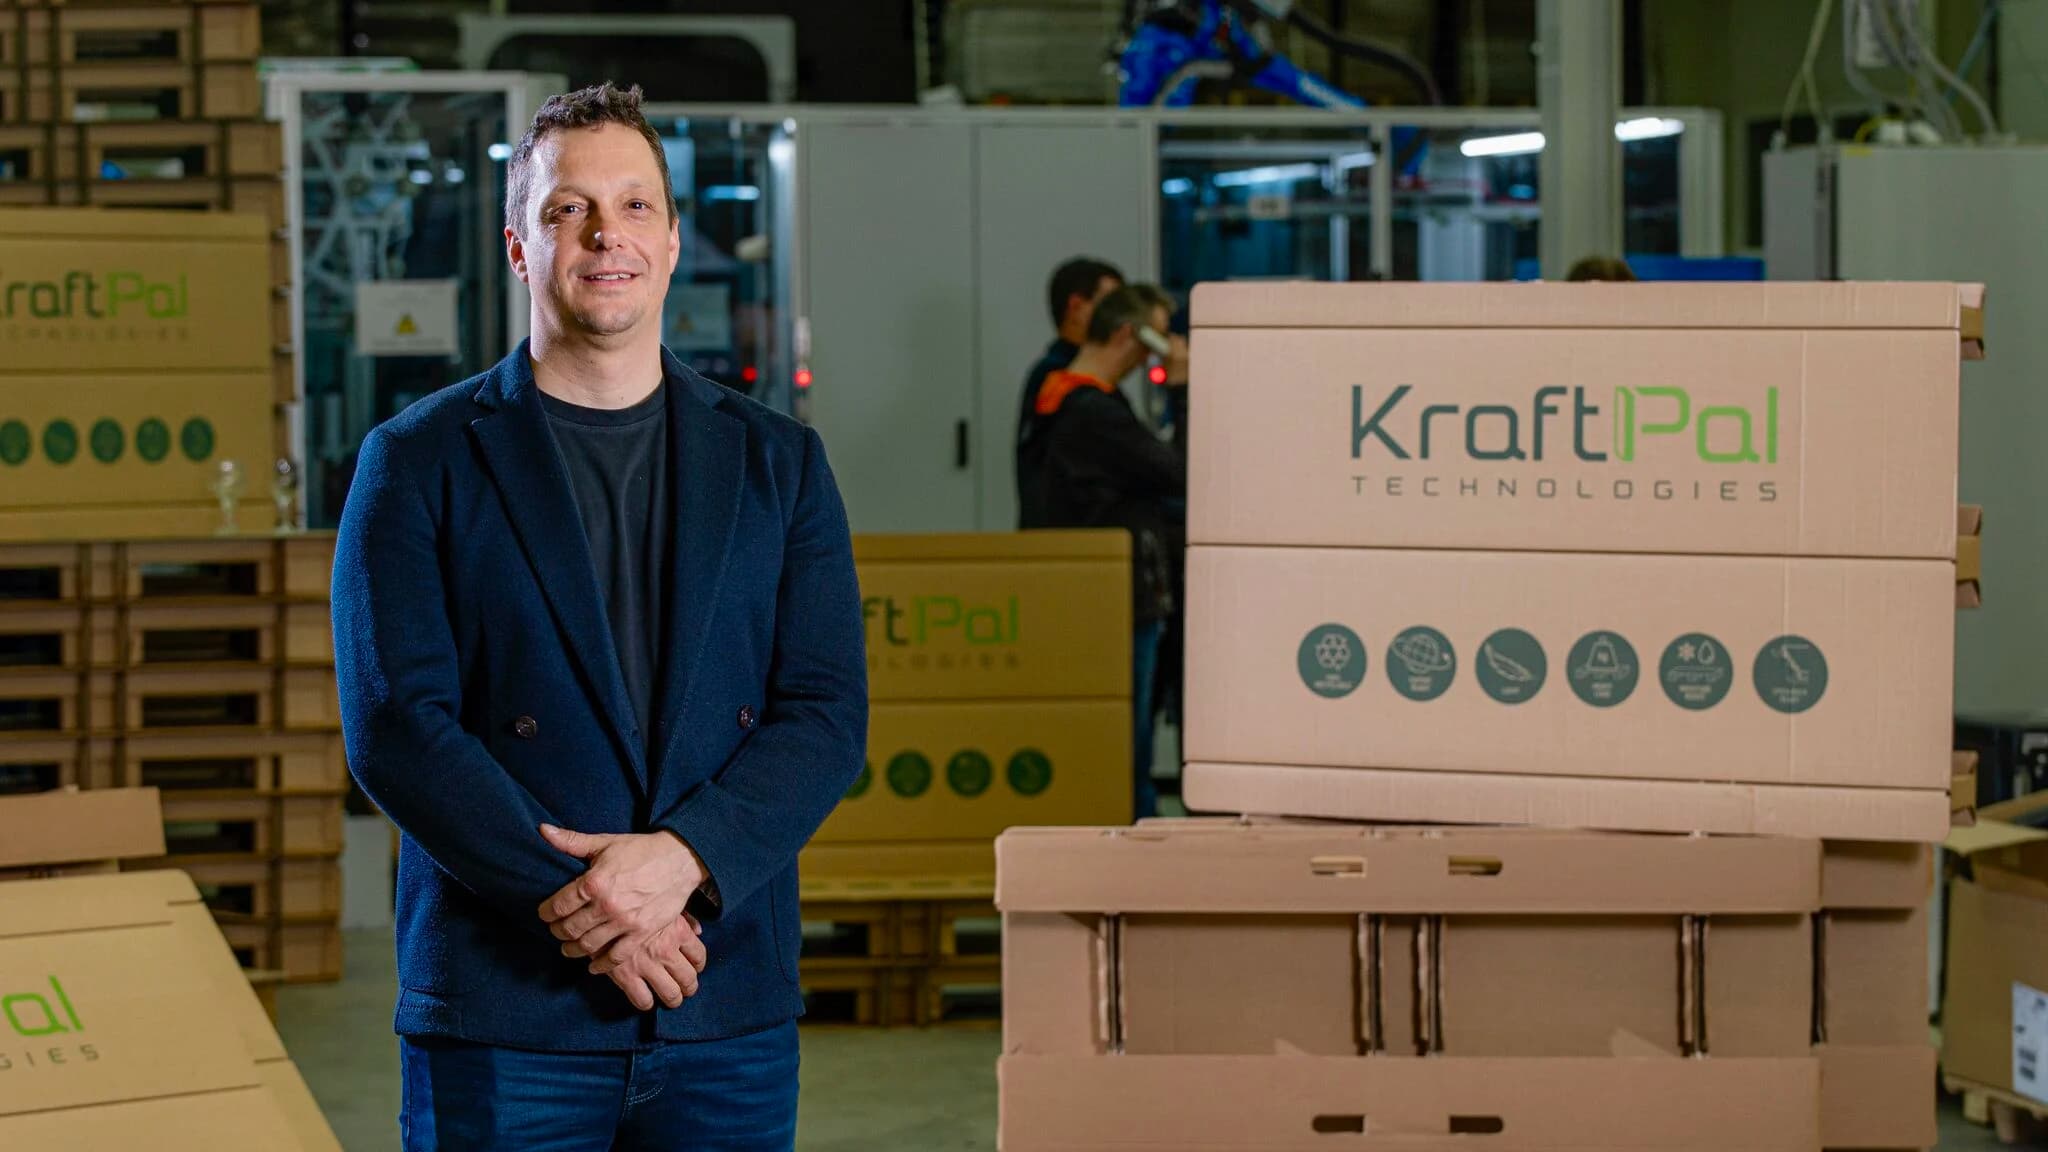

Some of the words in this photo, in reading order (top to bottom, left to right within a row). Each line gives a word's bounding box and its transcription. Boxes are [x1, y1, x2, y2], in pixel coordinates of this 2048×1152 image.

[0, 270, 188, 319] raftPal
[1351, 384, 1779, 464] KraftPal
[1352, 475, 1778, 502] TECHNOLOGIES
